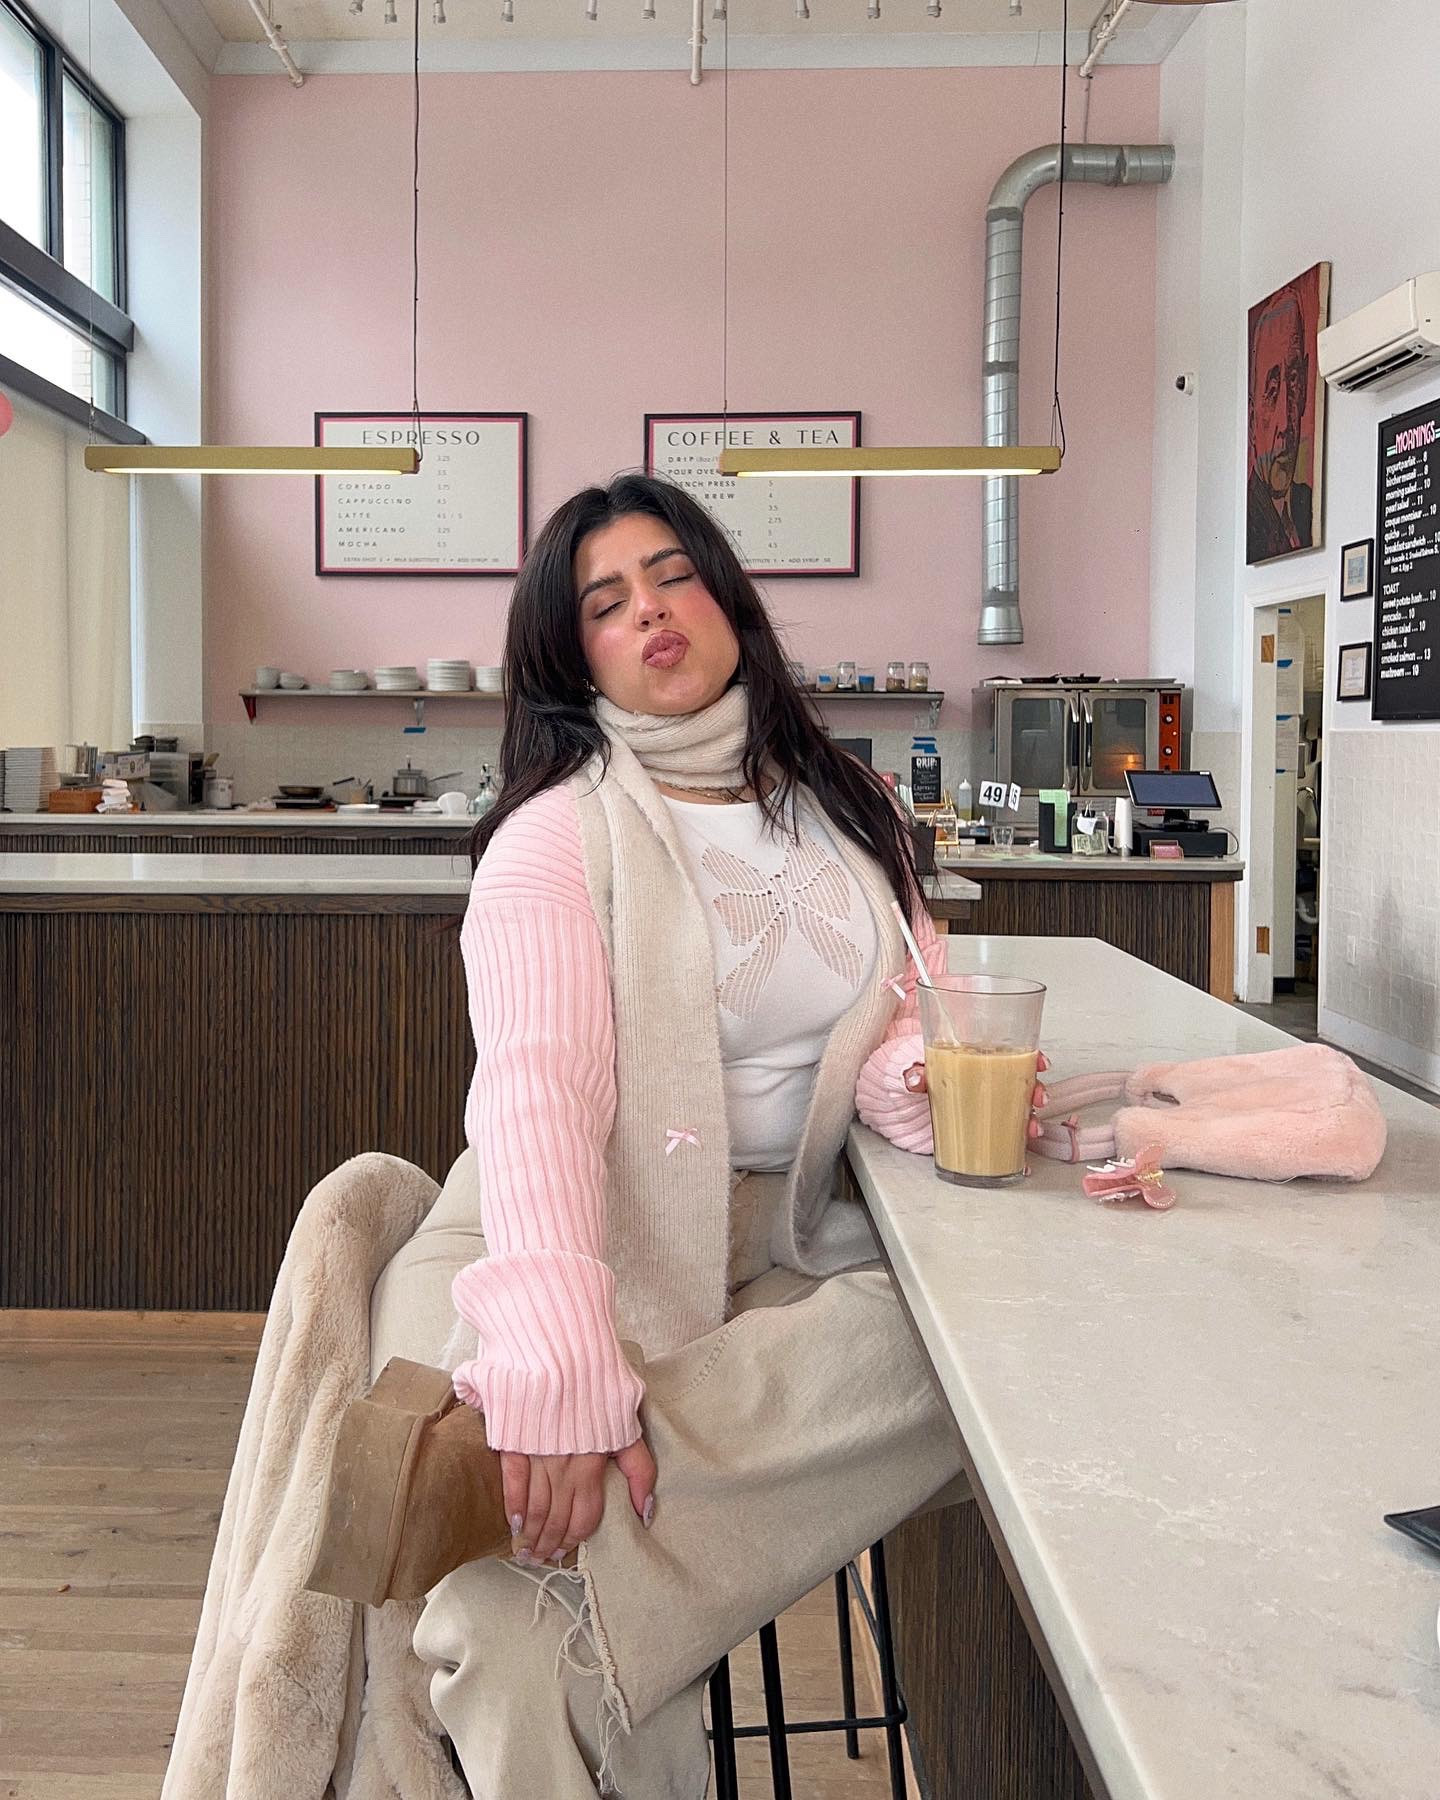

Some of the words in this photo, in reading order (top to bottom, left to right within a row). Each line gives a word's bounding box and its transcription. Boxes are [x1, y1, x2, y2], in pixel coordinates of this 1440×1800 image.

[362, 430, 480, 445] ESPRESSO
[668, 430, 754, 446] COFFEE
[769, 430, 781, 444] &
[796, 430, 839, 444] TEA
[1396, 420, 1435, 454] MORNINGS
[1386, 461, 1401, 476] yogurt
[1423, 451, 1428, 462] 8
[1424, 464, 1428, 475] 8
[1386, 488, 1404, 501] morning
[1405, 481, 1417, 495] salad
[1424, 478, 1431, 489] 10
[1397, 497, 1409, 510] salad
[1417, 495, 1423, 505] 11
[1430, 504, 1436, 515] 10
[1384, 529, 1400, 543] quiche
[1408, 524, 1415, 536] 10
[1384, 541, 1404, 555] breakfast
[1404, 535, 1426, 550] sandwich
[1383, 582, 1400, 596] TOAST
[1383, 597, 1396, 609] sweet
[1396, 596, 1410, 610] potato
[1411, 592, 1422, 604] hash
[1430, 589, 1436, 600] 10
[1382, 610, 1401, 623] avocado
[1409, 608, 1415, 619] 10
[1382, 626, 1398, 636] chicken
[1399, 622, 1411, 634] salad
[1419, 620, 1426, 631] 10
[1403, 636, 1407, 648] 8
[1381, 651, 1399, 664] smoked
[1399, 651, 1416, 662] salmon
[1424, 648, 1430, 660] 13
[1412, 664, 1419, 676] 10
[984, 786, 1002, 802] 49
